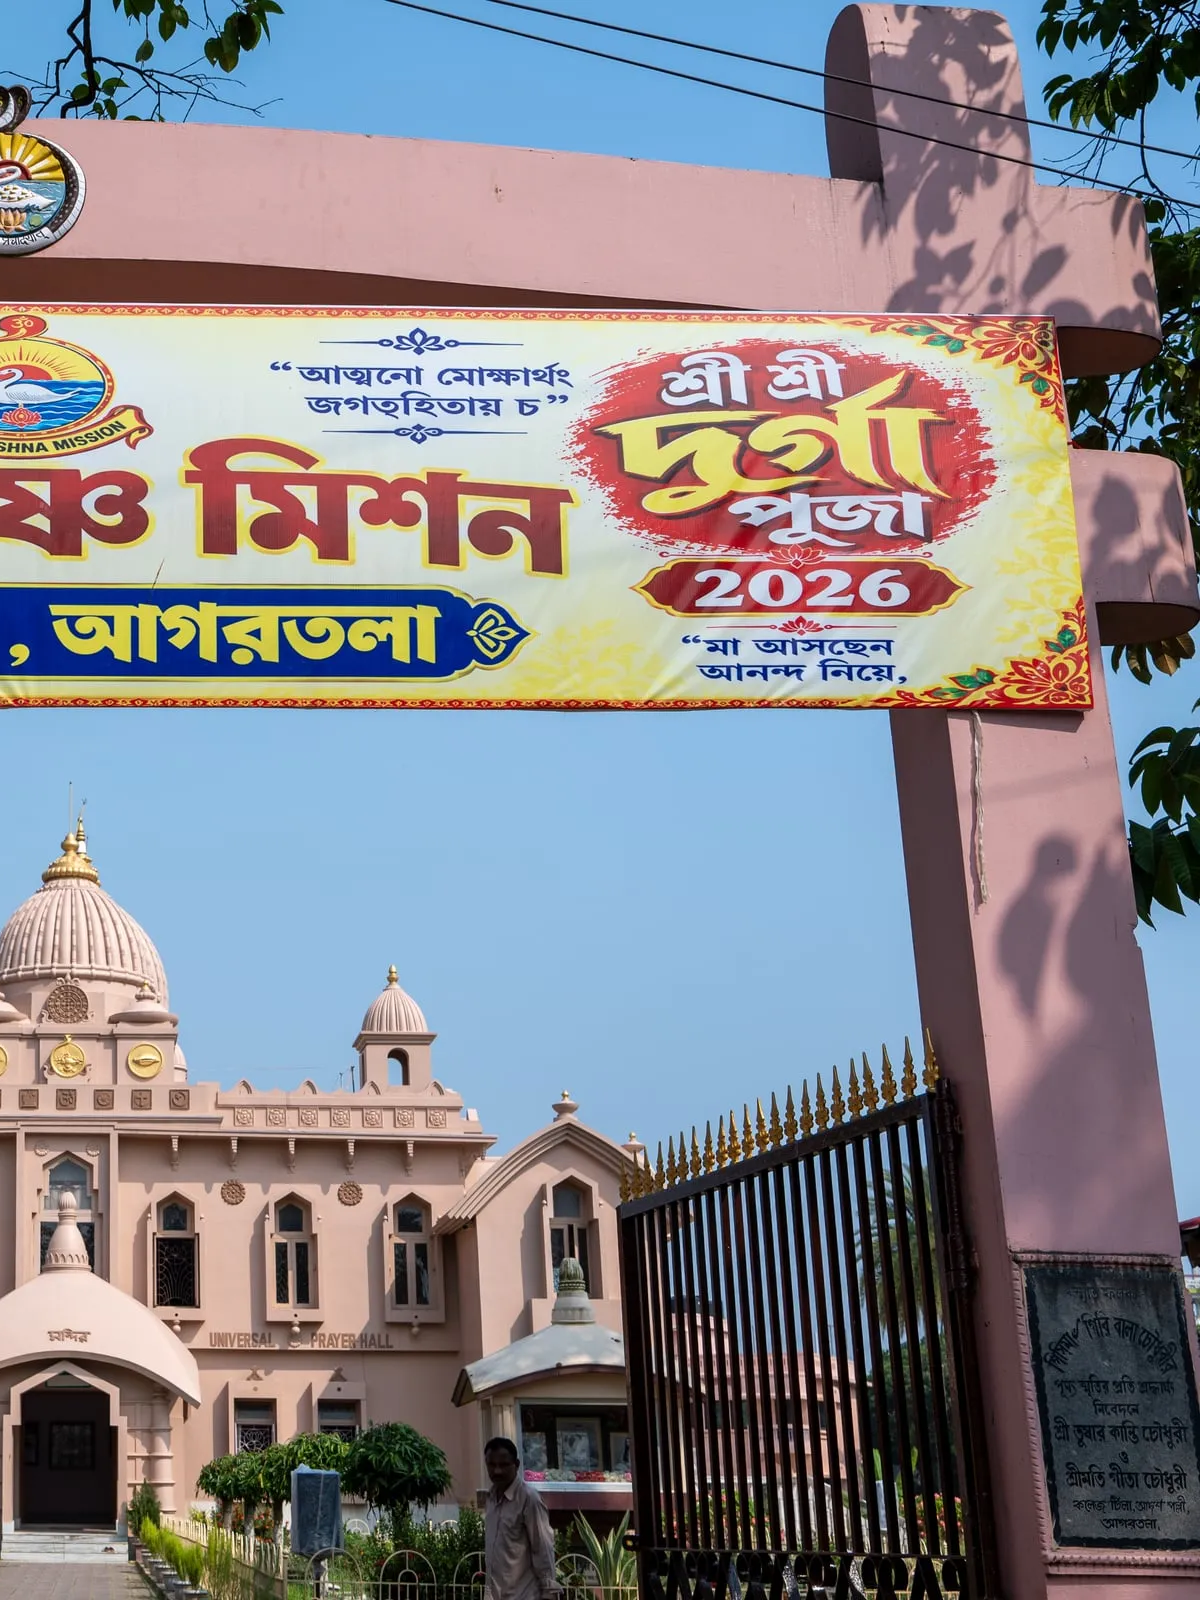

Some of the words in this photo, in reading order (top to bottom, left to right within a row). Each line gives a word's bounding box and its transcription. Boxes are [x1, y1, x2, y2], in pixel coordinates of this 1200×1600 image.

[437, 362, 574, 388] মোক্ষার্থং
[661, 352, 752, 407] শ্রী
[767, 349, 847, 400] শ্রী
[54, 421, 127, 453] MISSION
[594, 369, 952, 514] দুর্গা
[185, 438, 574, 575] মিশন
[727, 491, 934, 546] পূজা
[694, 568, 911, 608] 2026
[49, 602, 442, 664] আগরতলা
[751, 637, 895, 657] আসছেন
[696, 663, 807, 683] আনন্দ
[817, 659, 907, 685] নিয়ে,
[209, 1332, 276, 1348] UNIVERSAL
[310, 1332, 356, 1349] PRAYER
[360, 1333, 394, 1349] HALL
[1112, 1374, 1136, 1394] প্রতি
[1054, 1415, 1070, 1442] শ্রী
[1142, 1416, 1189, 1449] চৌধুরী
[1119, 1451, 1130, 1463] ও
[1065, 1461, 1106, 1488] শ্রীমতি
[1109, 1463, 1140, 1489] গীতা
[1143, 1463, 1189, 1494] চৌধুরী
